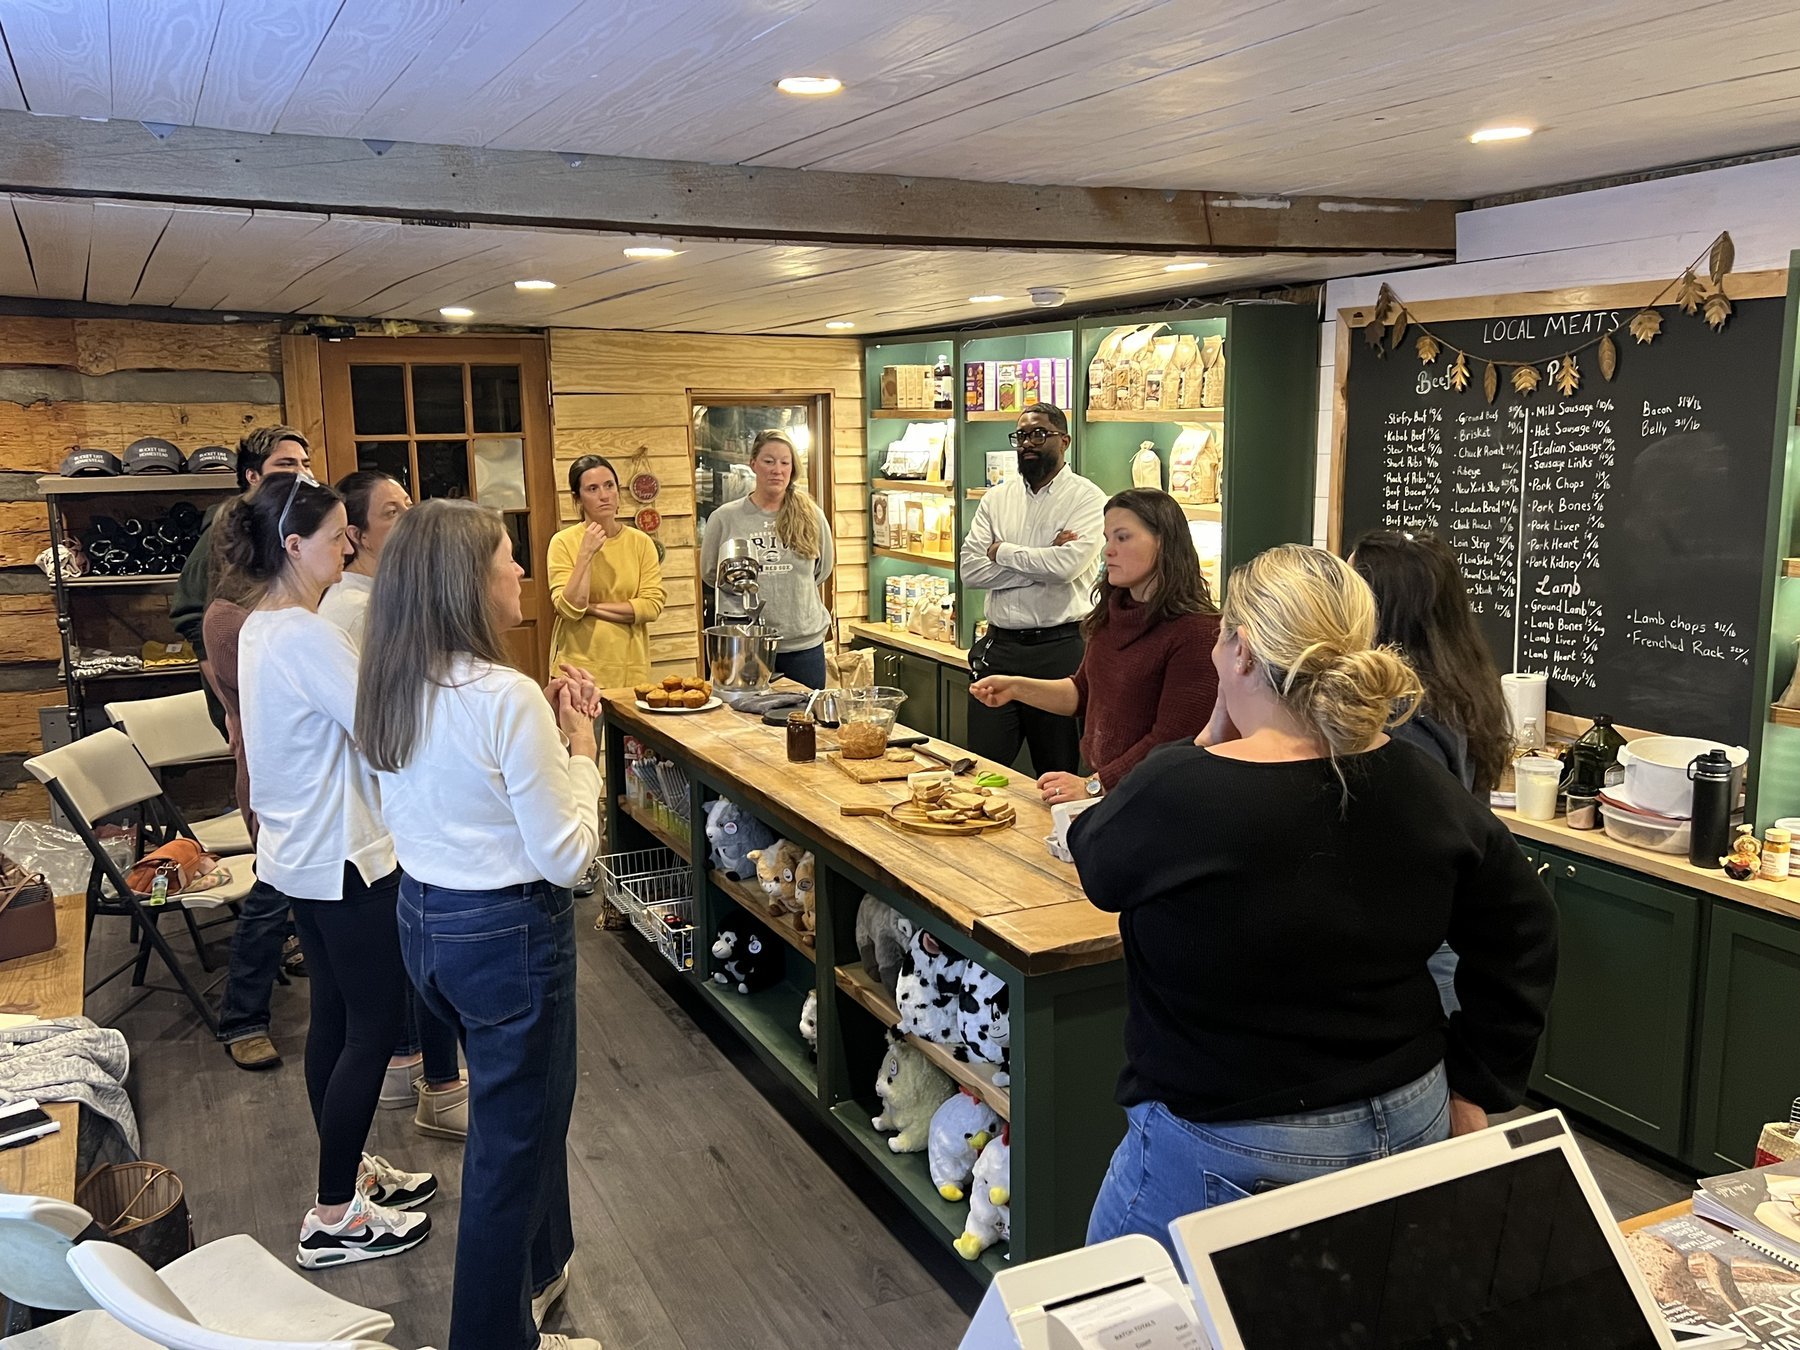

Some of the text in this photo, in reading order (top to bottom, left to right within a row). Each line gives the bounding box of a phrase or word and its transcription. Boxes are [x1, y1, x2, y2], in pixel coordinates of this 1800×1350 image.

[1483, 311, 1620, 344] LOCAL MEATS
[1415, 364, 1453, 395] Beef
[1536, 404, 1555, 417] Mild
[1558, 401, 1594, 418] Sausage
[1642, 400, 1673, 417] Bacon
[1458, 411, 1484, 426] Ground
[1460, 426, 1492, 442] Brisket
[1534, 419, 1612, 437] Hot Sausage $10/lb
[1641, 419, 1668, 437] Belly
[1406, 442, 1427, 453] Meat
[1458, 446, 1482, 459] Chuck
[1483, 443, 1505, 457] Roast
[1529, 440, 1567, 459] Italian
[1568, 441, 1602, 455] Sausage
[1456, 465, 1482, 479] Ribeye
[1533, 459, 1566, 473] Sausage
[1567, 456, 1593, 469] Links
[1386, 471, 1402, 484] Rack
[1403, 472, 1411, 485] of
[1411, 471, 1427, 484] Ribs
[1532, 476, 1552, 491] Pork
[1555, 476, 1584, 493] Chops
[1385, 485, 1401, 497] Beef
[1404, 485, 1427, 497] Bacon
[1455, 482, 1470, 494] New
[1470, 481, 1486, 494] York
[1386, 499, 1400, 511] Beef
[1402, 499, 1423, 512] Liver
[1454, 501, 1482, 514] London
[1531, 499, 1554, 514] Pork
[1558, 497, 1592, 513] Bones
[1386, 514, 1402, 527] Beef
[1402, 514, 1428, 531] Kidney
[1531, 519, 1550, 532] Pork
[1553, 519, 1581, 532] Liver
[1470, 535, 1490, 554] Strip
[1530, 538, 1550, 551] Pork
[1551, 536, 1580, 550] Heart
[1529, 555, 1548, 569] Pork
[1549, 554, 1582, 573] Kidney
[1535, 574, 1581, 598] Lamb
[1530, 598, 1563, 613] Ground
[1564, 599, 1587, 617] Lamb
[1530, 615, 1555, 631] Lamb
[1557, 617, 1583, 631] Bones
[1633, 608, 1665, 625] Lamb
[1670, 614, 1706, 635] chops
[1529, 631, 1551, 644] Lamb
[1555, 633, 1577, 646] Liver
[1632, 629, 1685, 652] Frenched
[1692, 639, 1726, 660] Rack
[1528, 648, 1548, 660] Lamb
[1553, 649, 1577, 663] Heart
[1552, 665, 1582, 688] Kidney
[1676, 1234, 1717, 1250] BITTMAN
